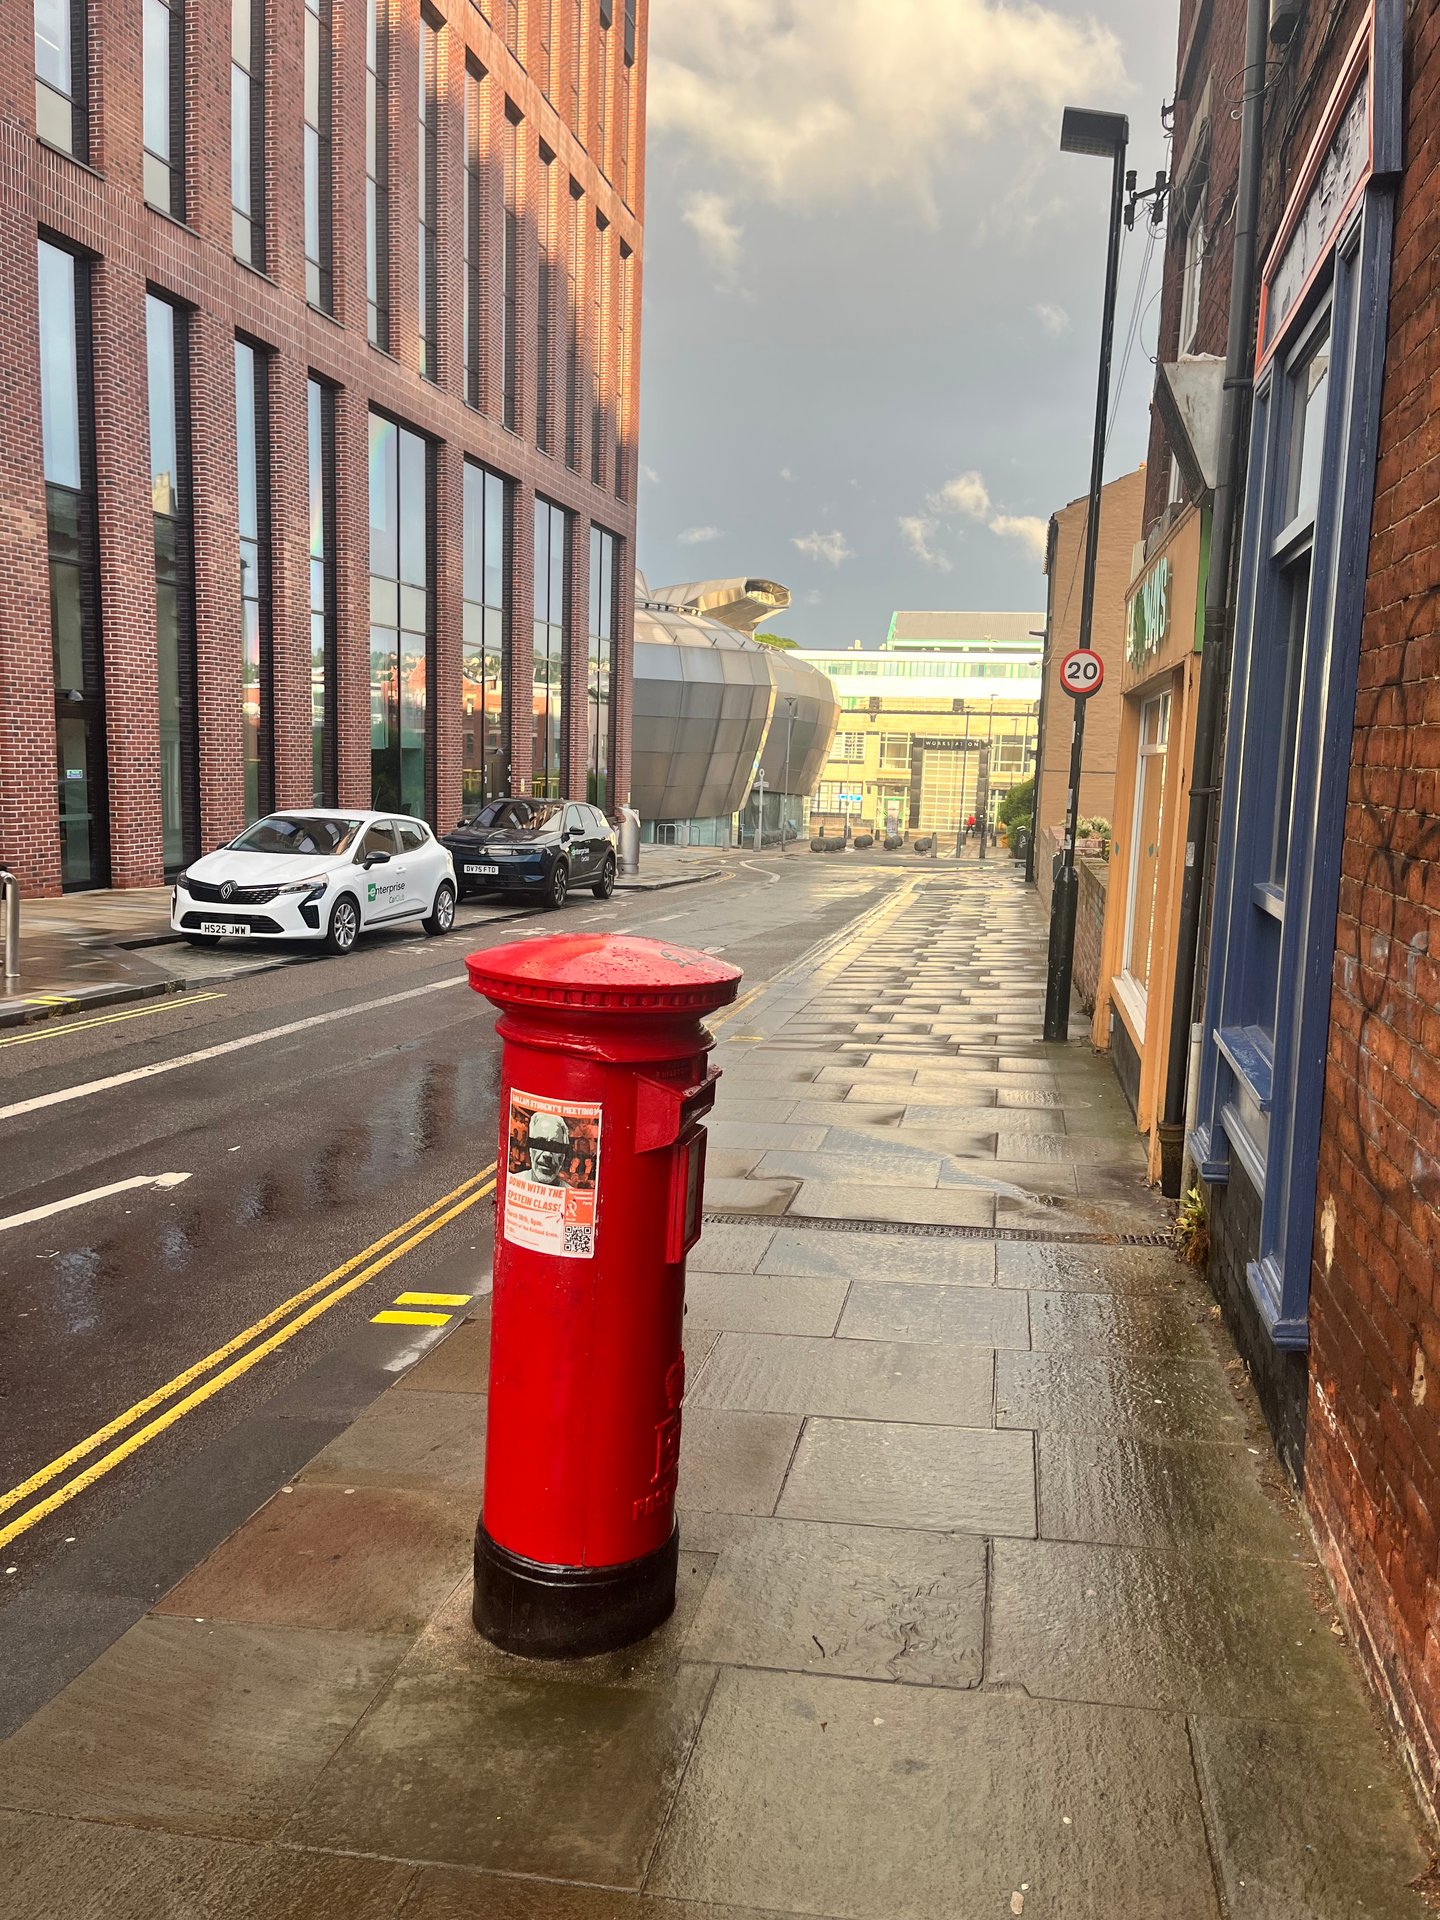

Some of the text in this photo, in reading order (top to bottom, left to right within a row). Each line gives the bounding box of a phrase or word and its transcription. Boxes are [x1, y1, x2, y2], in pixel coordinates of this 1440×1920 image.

[1067, 661, 1098, 680] 20
[924, 740, 979, 748] WORKSTATON
[368, 881, 406, 898] enterprise
[204, 924, 246, 935] HS25 JWW
[509, 1175, 565, 1199] DOWN WITH THE
[508, 1190, 562, 1213] EPSTEIN CLASS!
